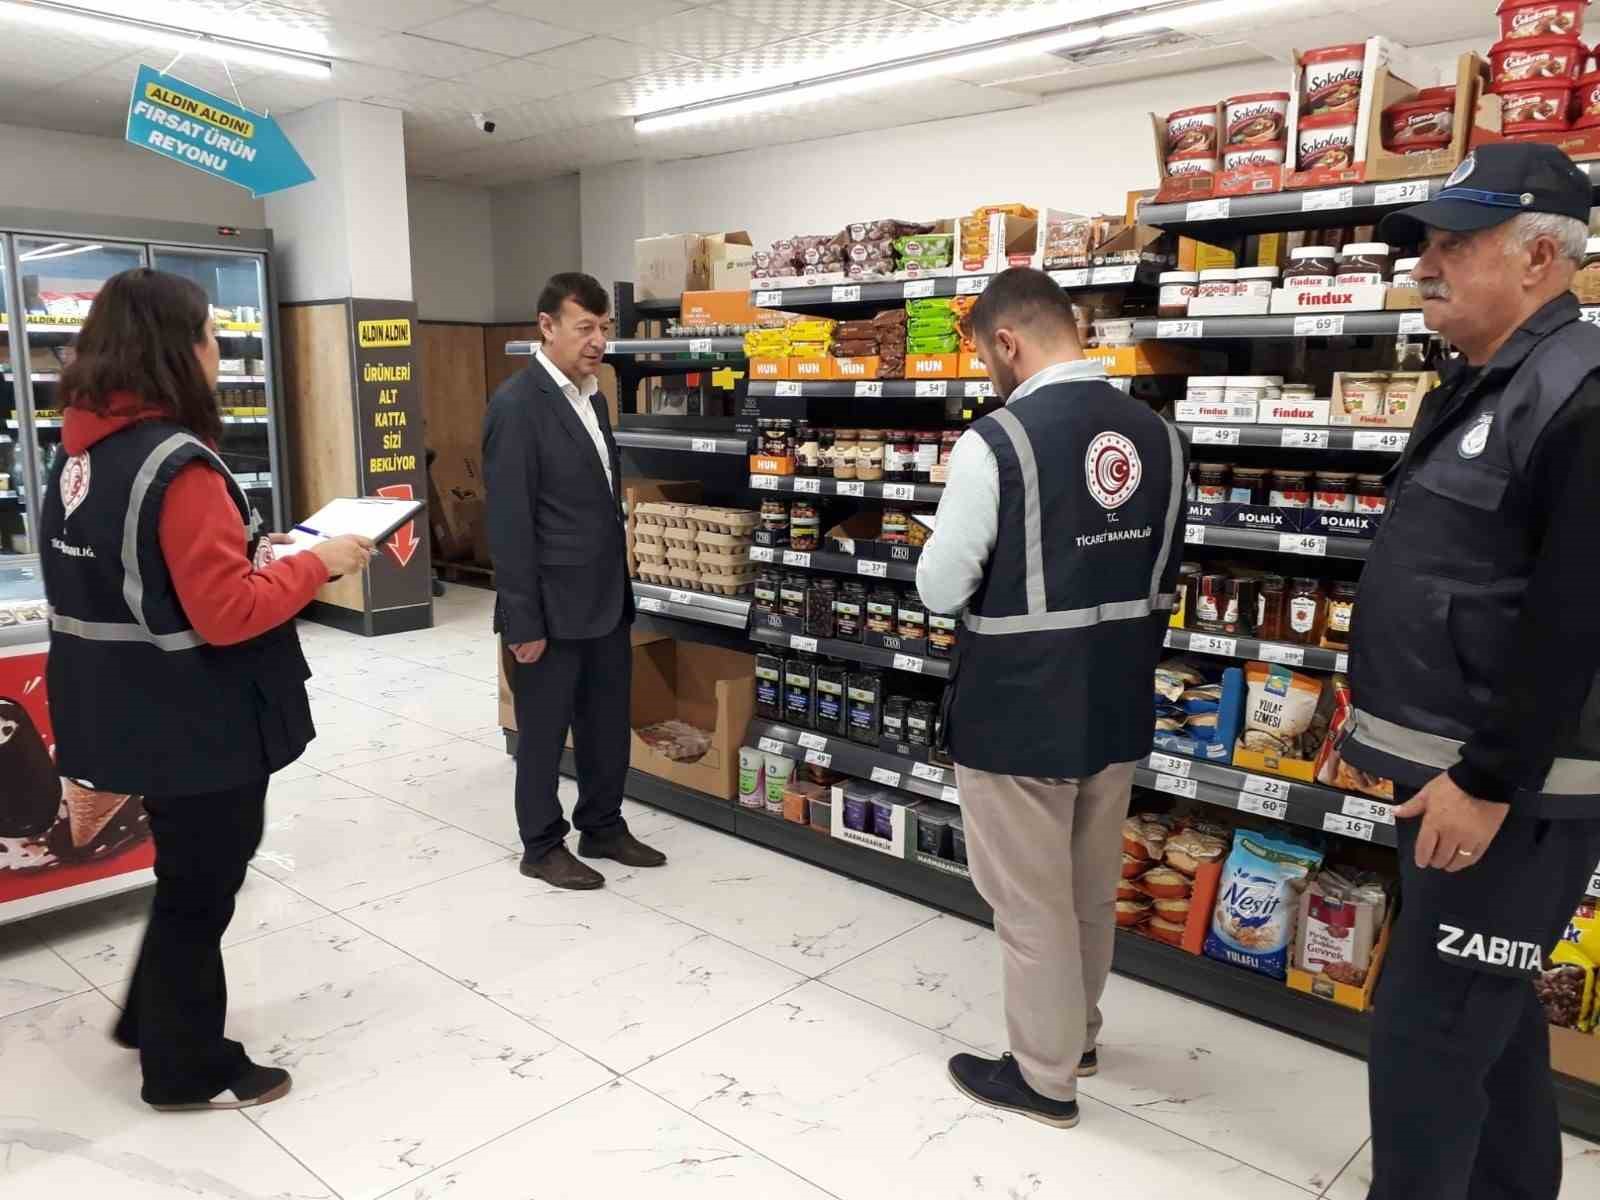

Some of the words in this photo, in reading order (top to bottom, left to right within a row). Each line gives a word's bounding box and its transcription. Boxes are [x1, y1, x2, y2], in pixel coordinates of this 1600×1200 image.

[1309, 66, 1362, 92] Sokoley
[150, 88, 198, 114] ALDIN
[199, 108, 250, 134] ALDIN!
[1232, 104, 1274, 124] Sokoley
[1169, 118, 1204, 137] Sokoley
[204, 126, 256, 162] ÜRÜN
[1300, 132, 1349, 156] Sokoley
[148, 130, 228, 172] REYONU
[1400, 185, 1416, 198] 37
[1290, 278, 1322, 286] findux
[1298, 292, 1352, 306] findux
[26, 316, 57, 325] ALDIN
[1316, 319, 1332, 330] 69
[362, 326, 384, 342] ALDIN
[384, 324, 409, 341] ALDIN!
[1176, 322, 1190, 332] 37
[363, 362, 410, 382] ÜRÜNLERİ
[757, 363, 777, 374] HUN
[798, 362, 820, 374] HUN
[916, 360, 943, 372] HUN
[979, 384, 990, 392] 54
[378, 389, 398, 404] ALT
[1200, 407, 1228, 416] findux
[1272, 408, 1314, 418] findux
[375, 412, 406, 428] KATTA
[383, 431, 402, 450] SİZİ
[1216, 430, 1230, 440] 49
[1304, 432, 1318, 442] 32
[1380, 435, 1397, 446] 49
[370, 454, 416, 472] BEKLİYOR
[758, 460, 776, 470] HUN
[1238, 512, 1283, 525] BOLMİX
[1320, 515, 1368, 529] BOLMİX
[1300, 538, 1316, 548] 46
[1209, 639, 1222, 648] 51
[1259, 700, 1283, 713] YULAF
[1168, 759, 1180, 768] 33
[1174, 778, 1187, 788] 33
[1264, 782, 1279, 793] 22
[1262, 800, 1277, 810] 60
[1370, 806, 1386, 816] 58
[1346, 821, 1360, 832] 16
[1436, 923, 1543, 972] ZABITA
